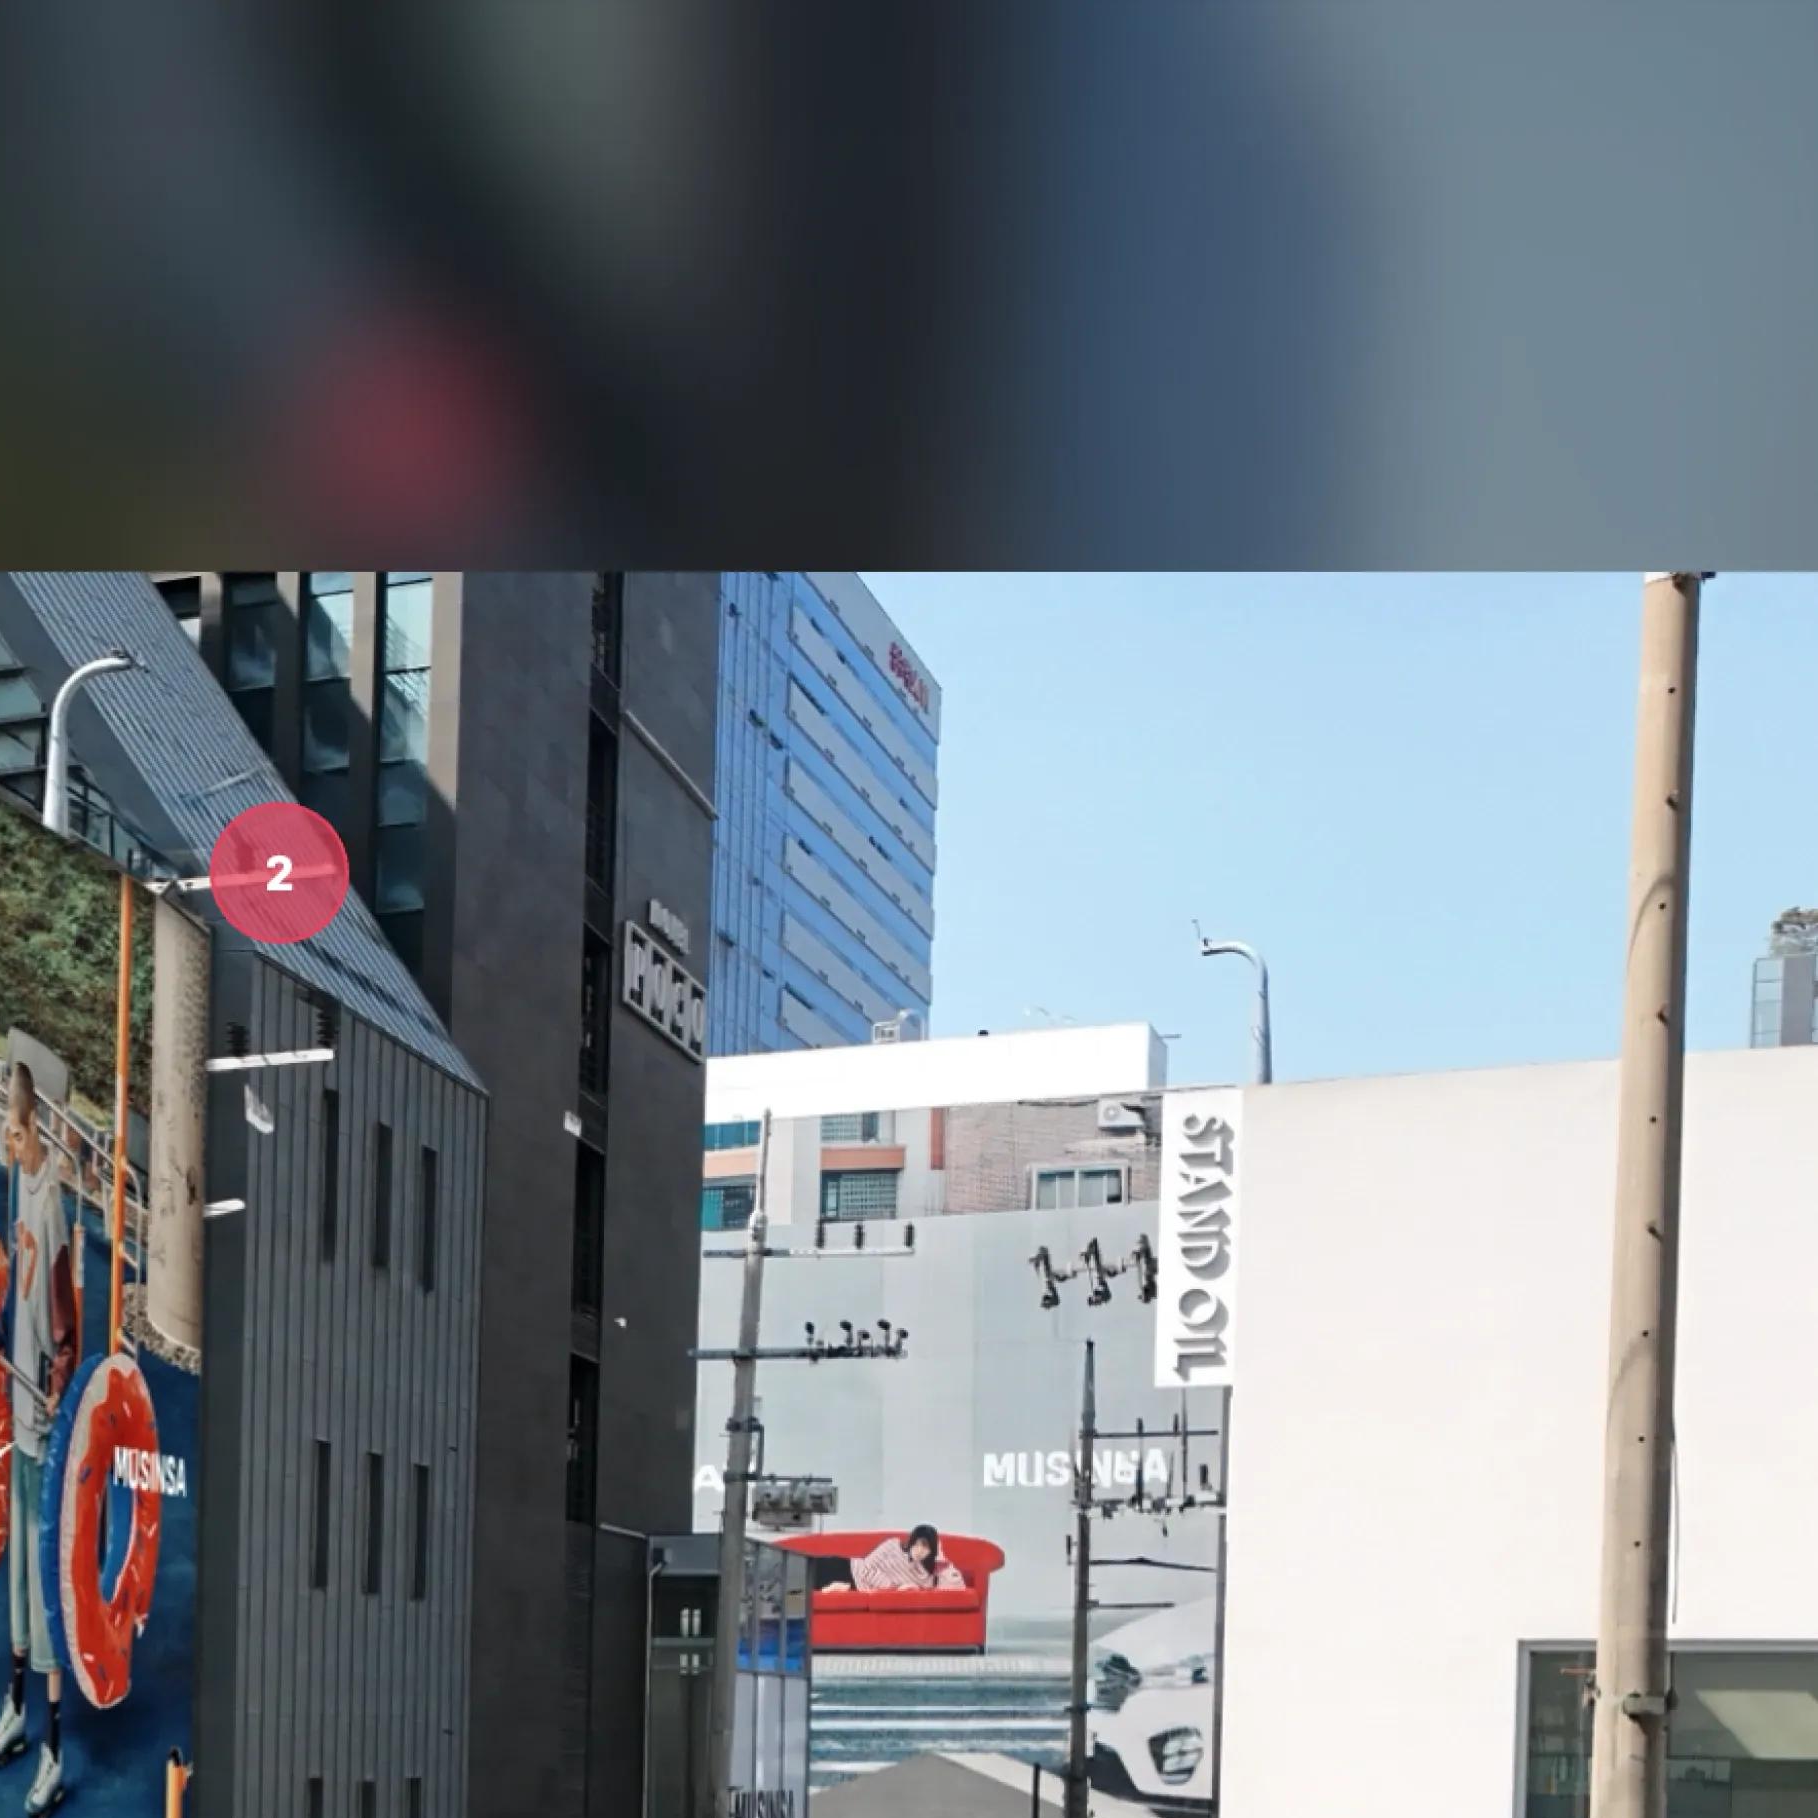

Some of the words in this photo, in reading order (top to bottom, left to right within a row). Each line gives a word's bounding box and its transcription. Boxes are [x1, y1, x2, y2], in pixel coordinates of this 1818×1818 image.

[1177, 1113, 1235, 1281] STAND
[1173, 1288, 1230, 1382] OIL
[112, 1446, 188, 1498] MUSINSA
